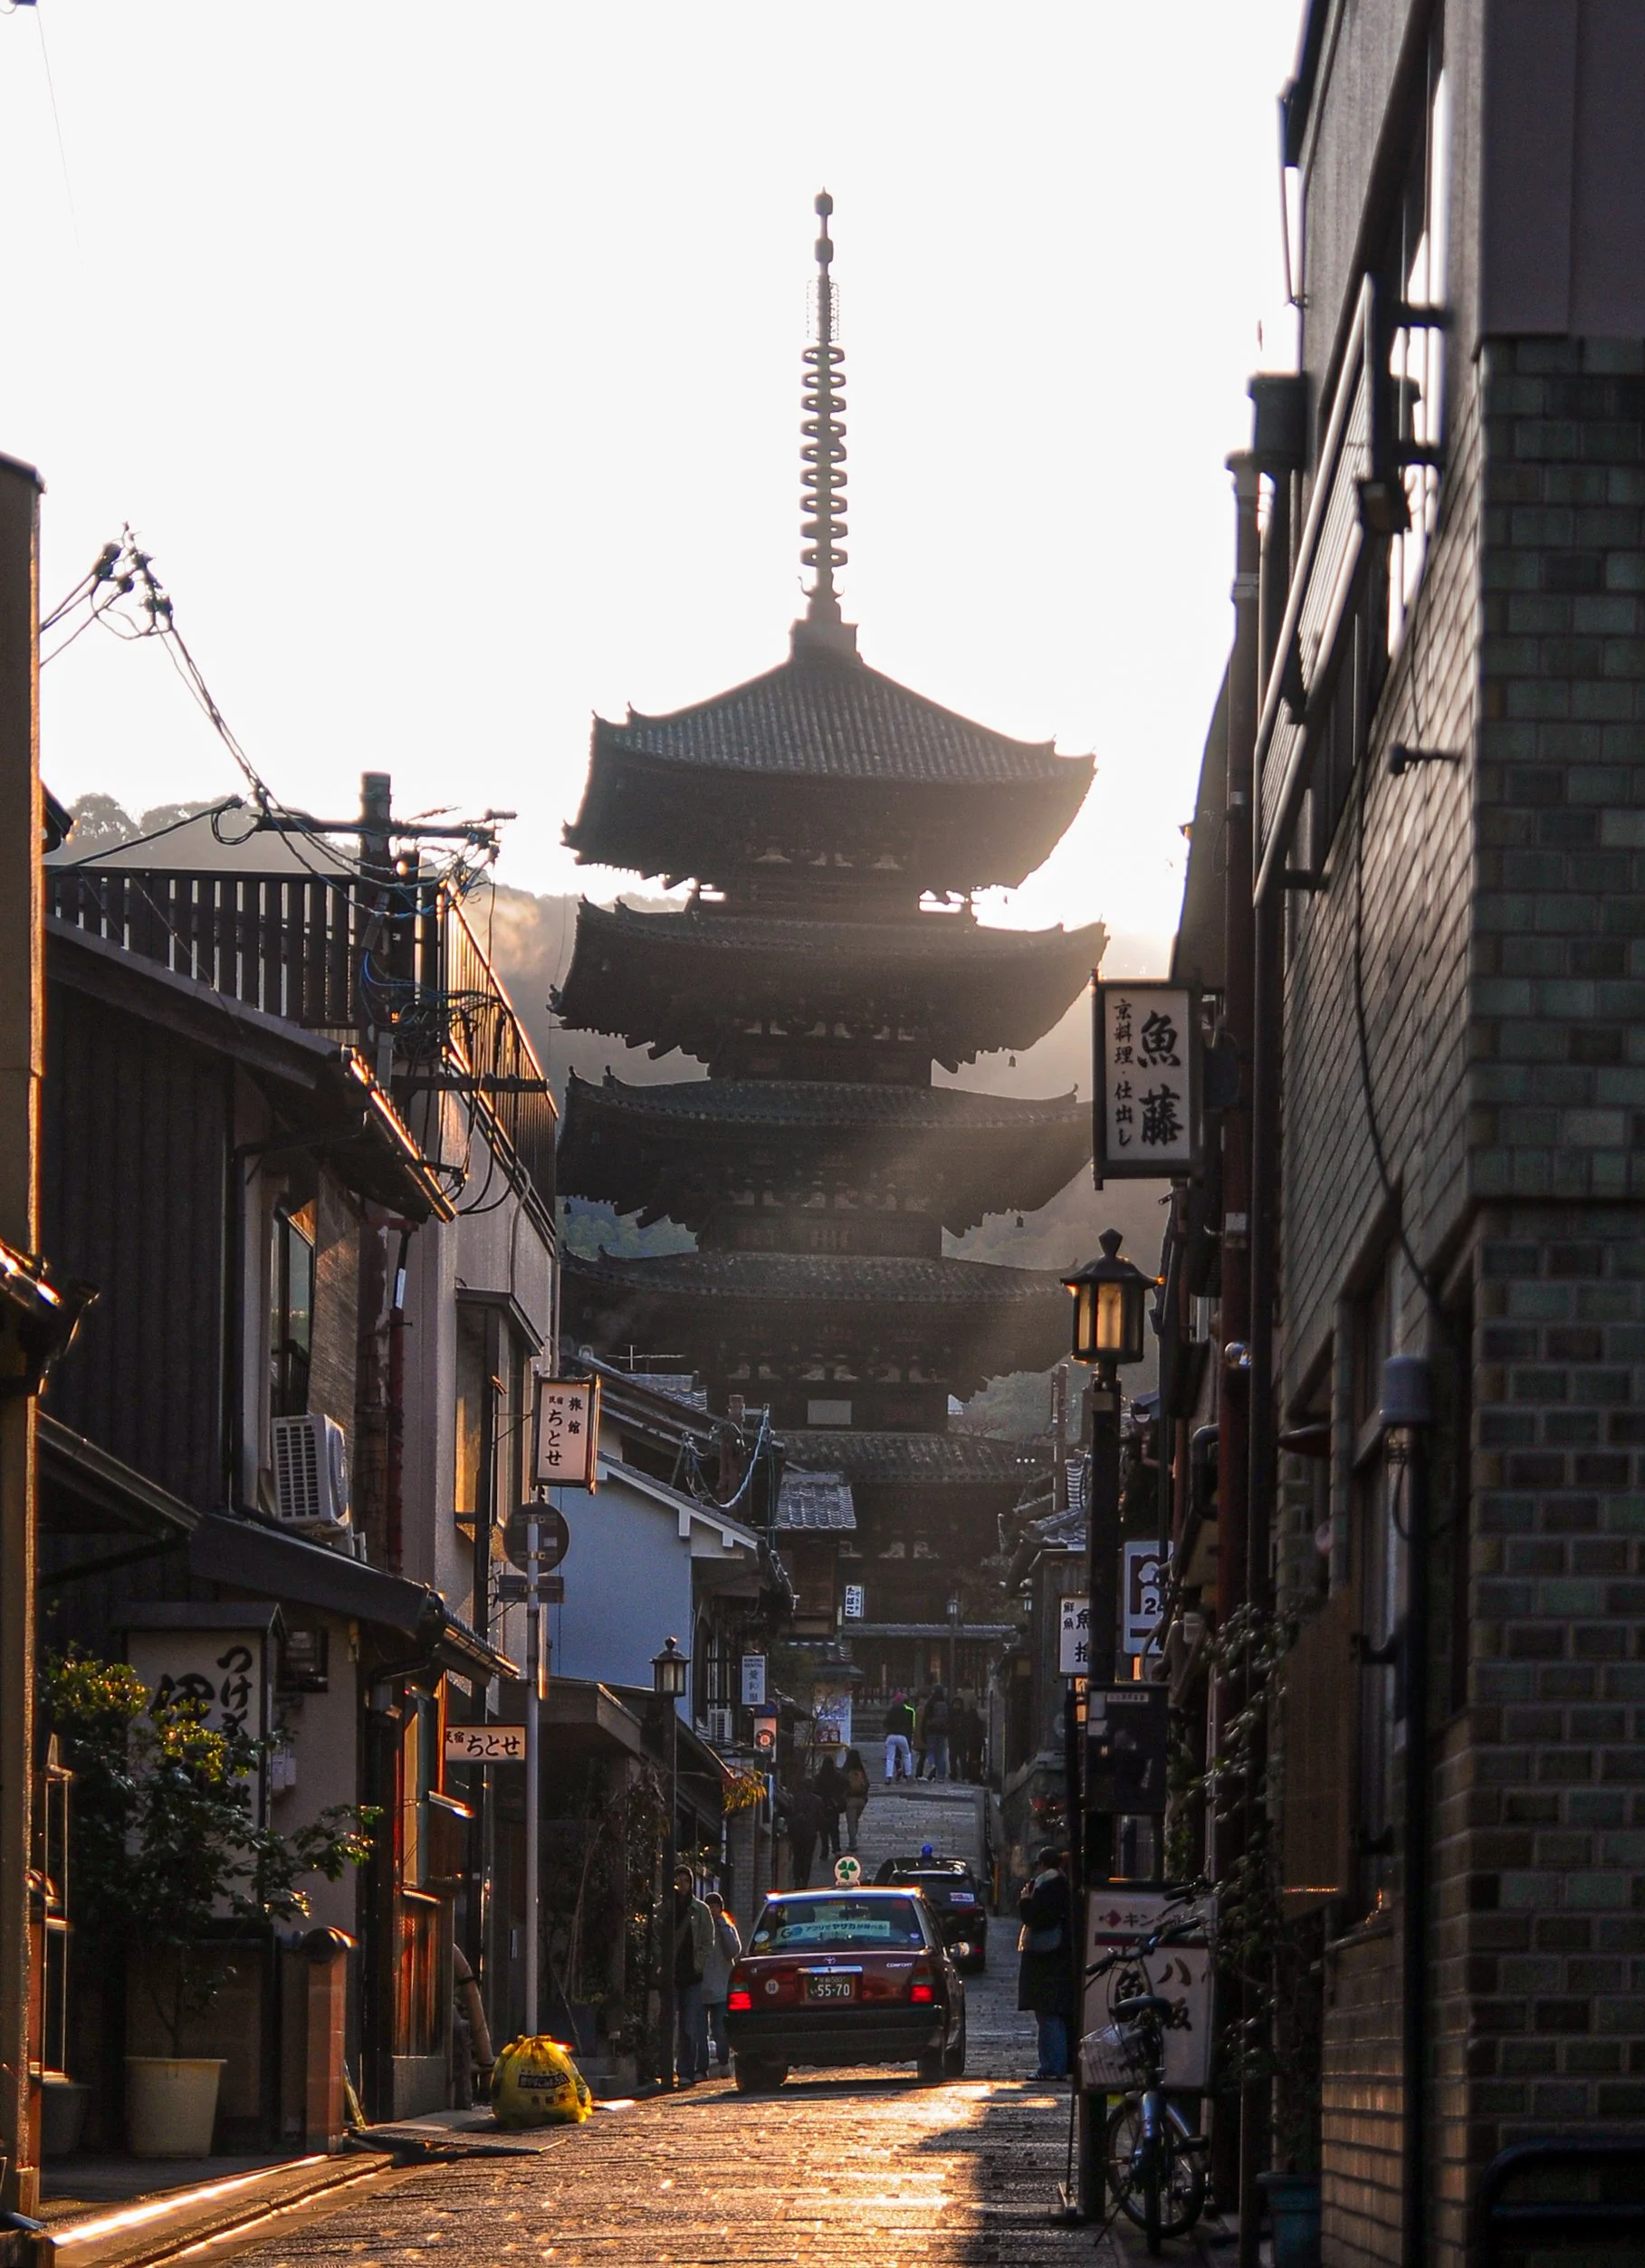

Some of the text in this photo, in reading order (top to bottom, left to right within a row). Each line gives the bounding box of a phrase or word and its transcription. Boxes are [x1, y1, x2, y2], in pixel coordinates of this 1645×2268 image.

[1137, 1010, 1184, 1146] 魚藤
[546, 1410, 562, 1467] ちとせ
[568, 1396, 584, 1435] 旅館
[466, 1734, 521, 1757] ちとせ
